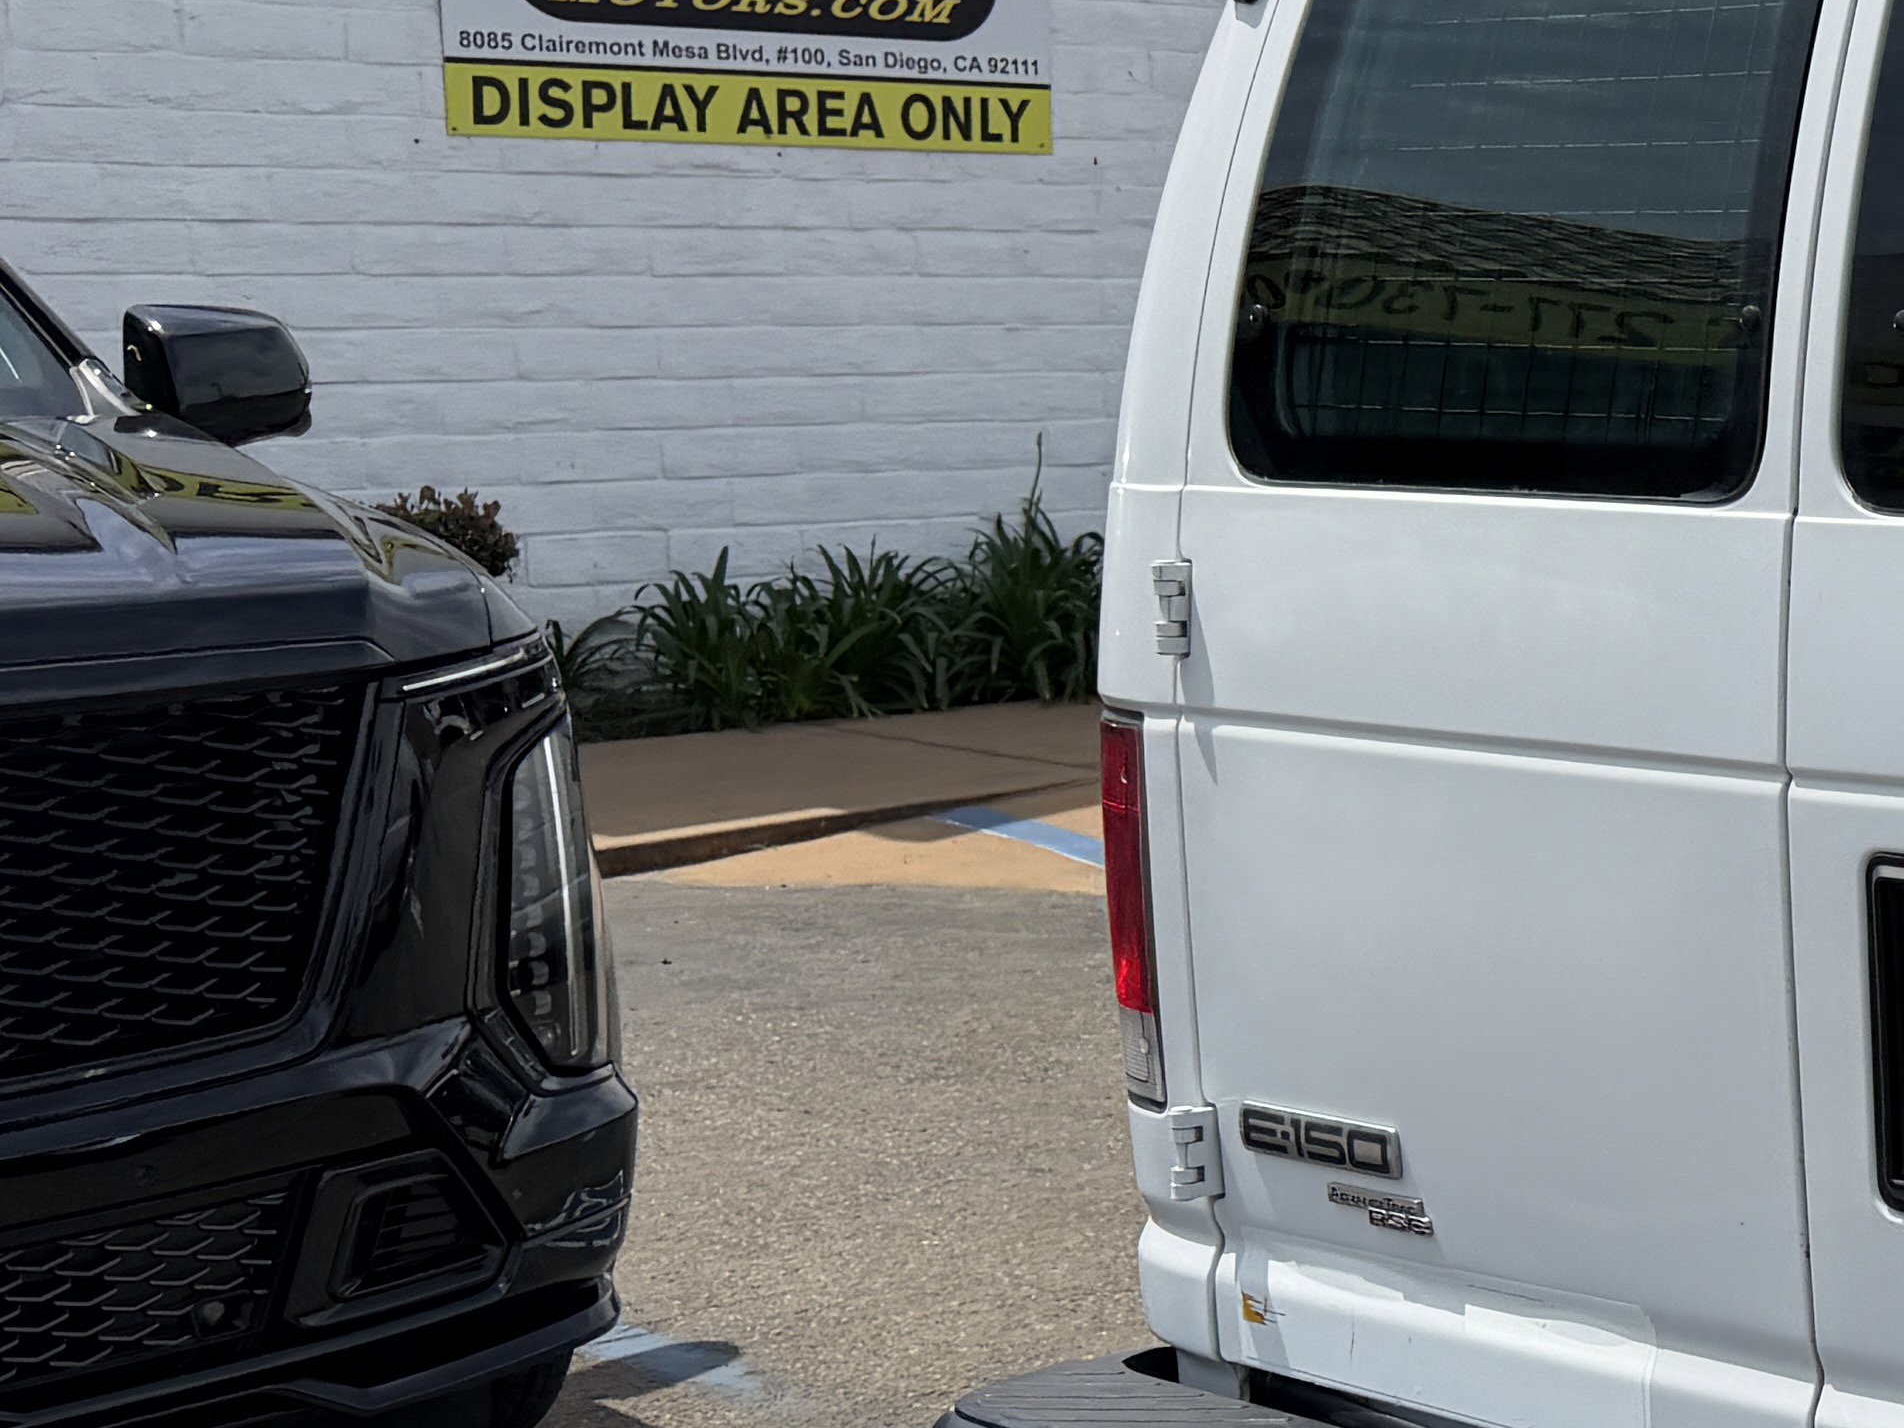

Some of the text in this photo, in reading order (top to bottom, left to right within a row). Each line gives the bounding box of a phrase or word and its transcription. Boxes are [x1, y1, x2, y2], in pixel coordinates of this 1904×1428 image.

[458, 29, 1041, 76] 8085 Clairemont Mesa Blvd, #100, San Diego, CA 92111
[471, 74, 1032, 144] DISPLAY AREA ONLY
